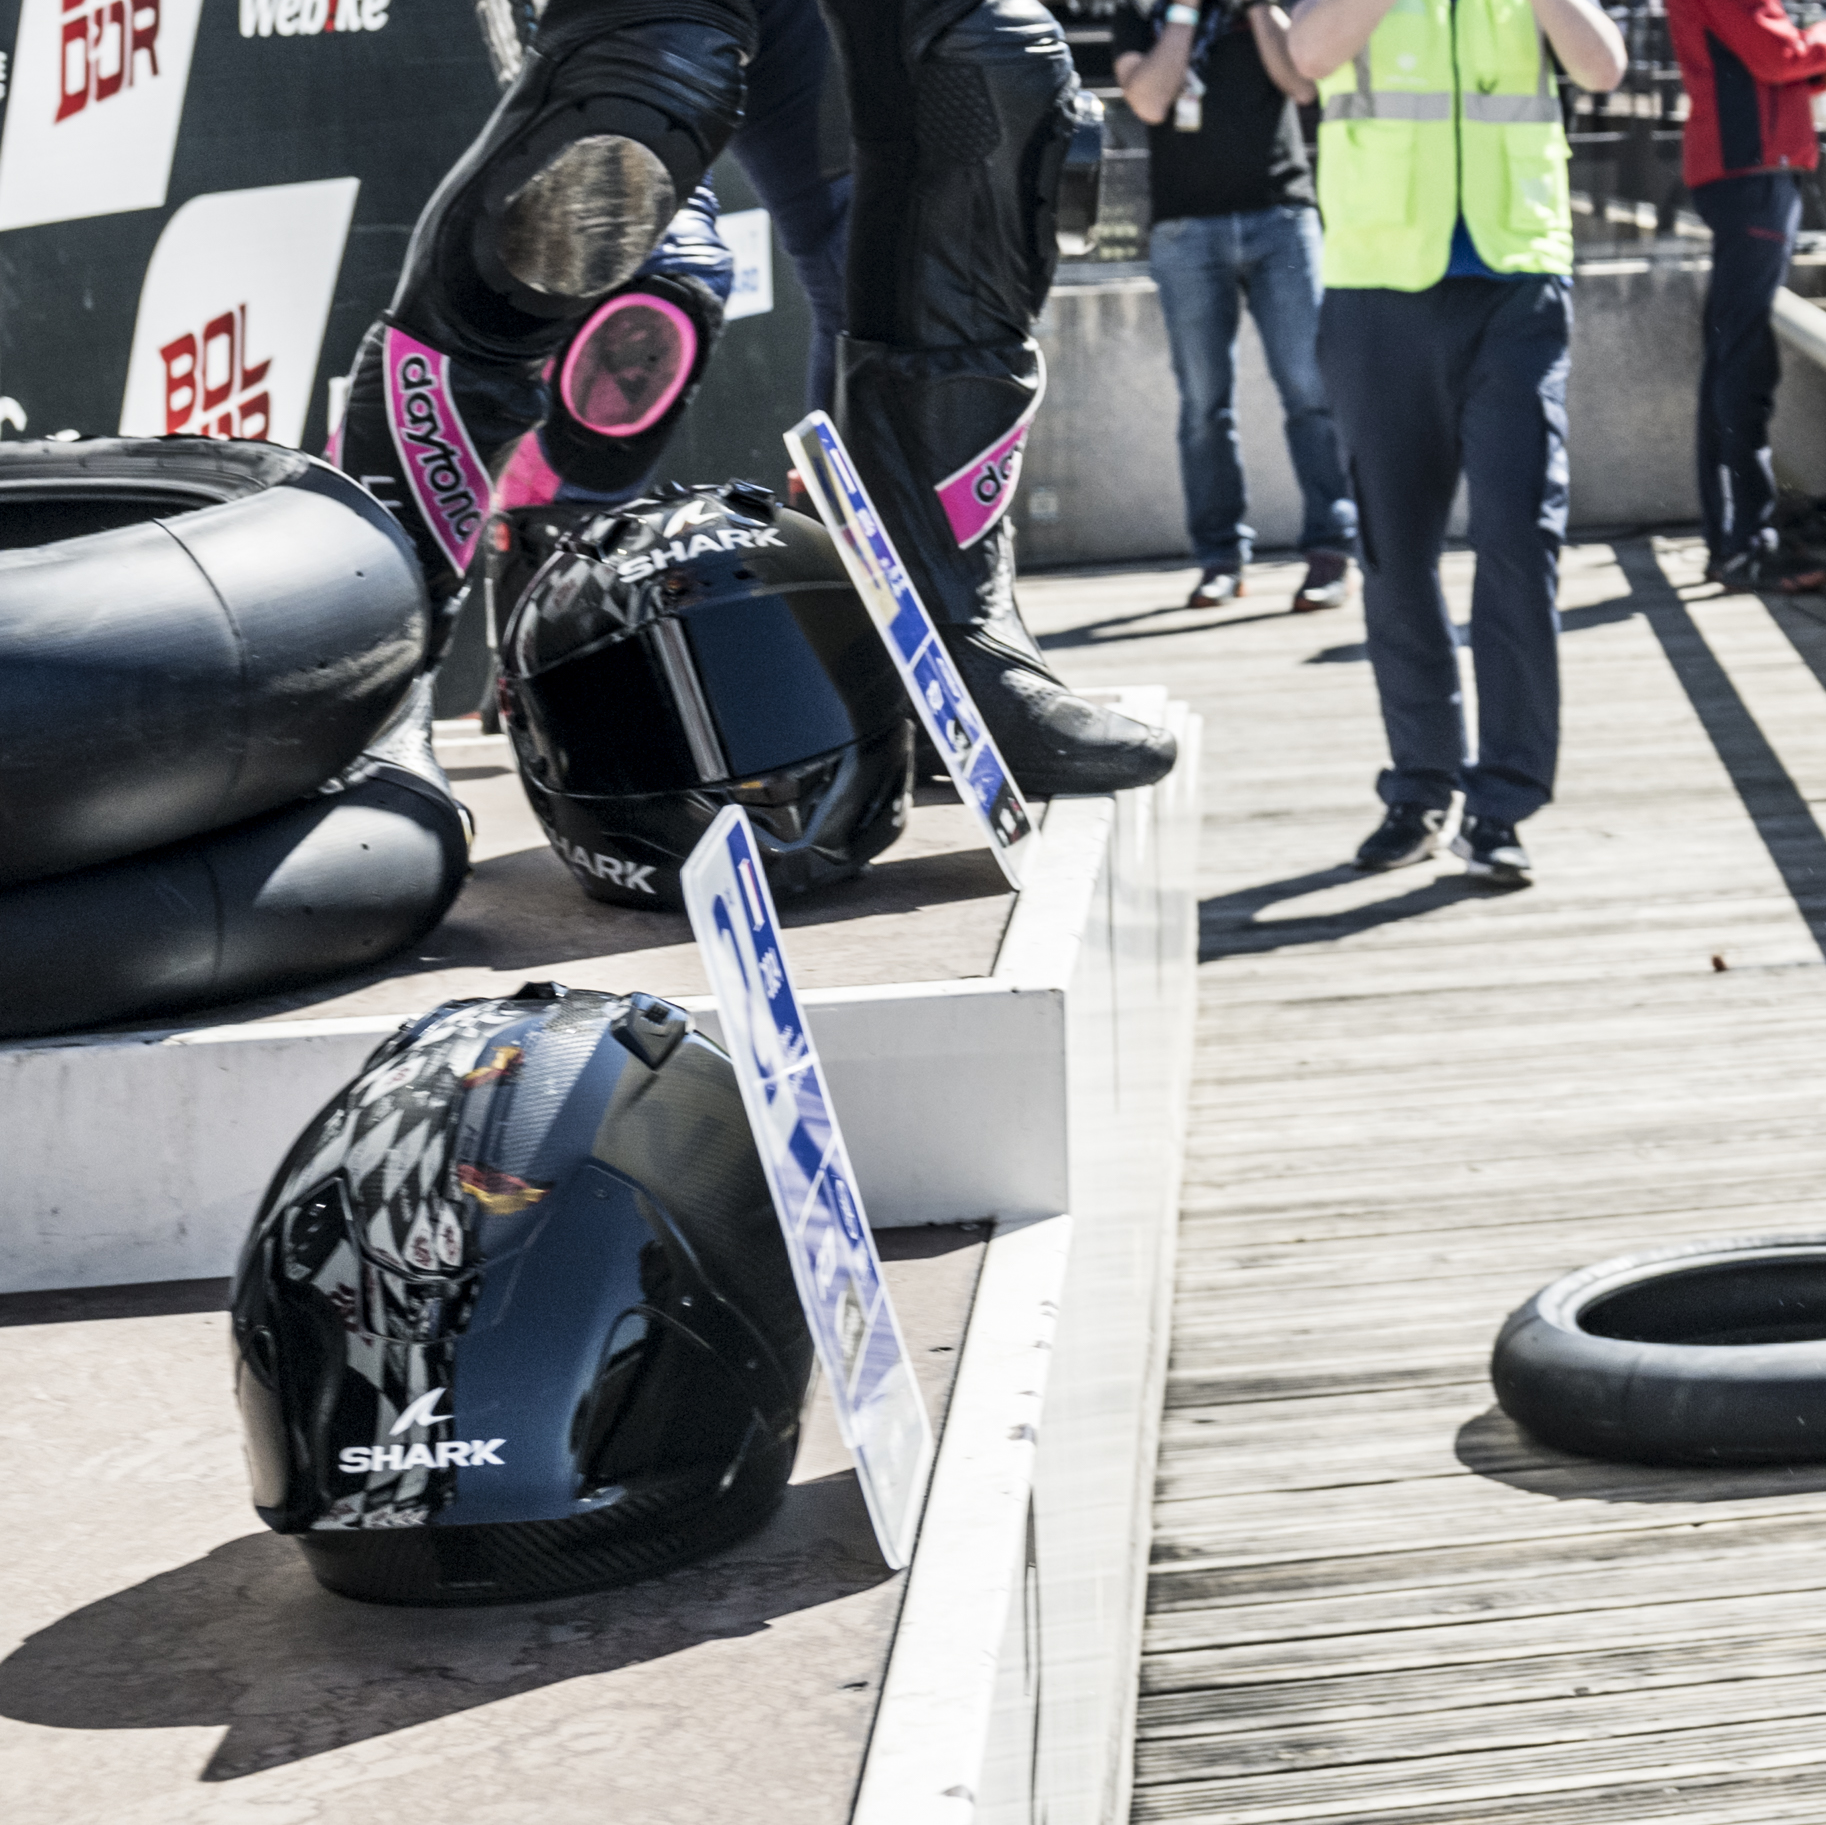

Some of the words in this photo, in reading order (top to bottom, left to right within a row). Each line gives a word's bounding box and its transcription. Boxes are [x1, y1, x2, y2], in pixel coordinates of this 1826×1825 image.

[159, 302, 273, 435] BOL
[617, 527, 788, 583] SHARK
[338, 1438, 507, 1474] SHARK
